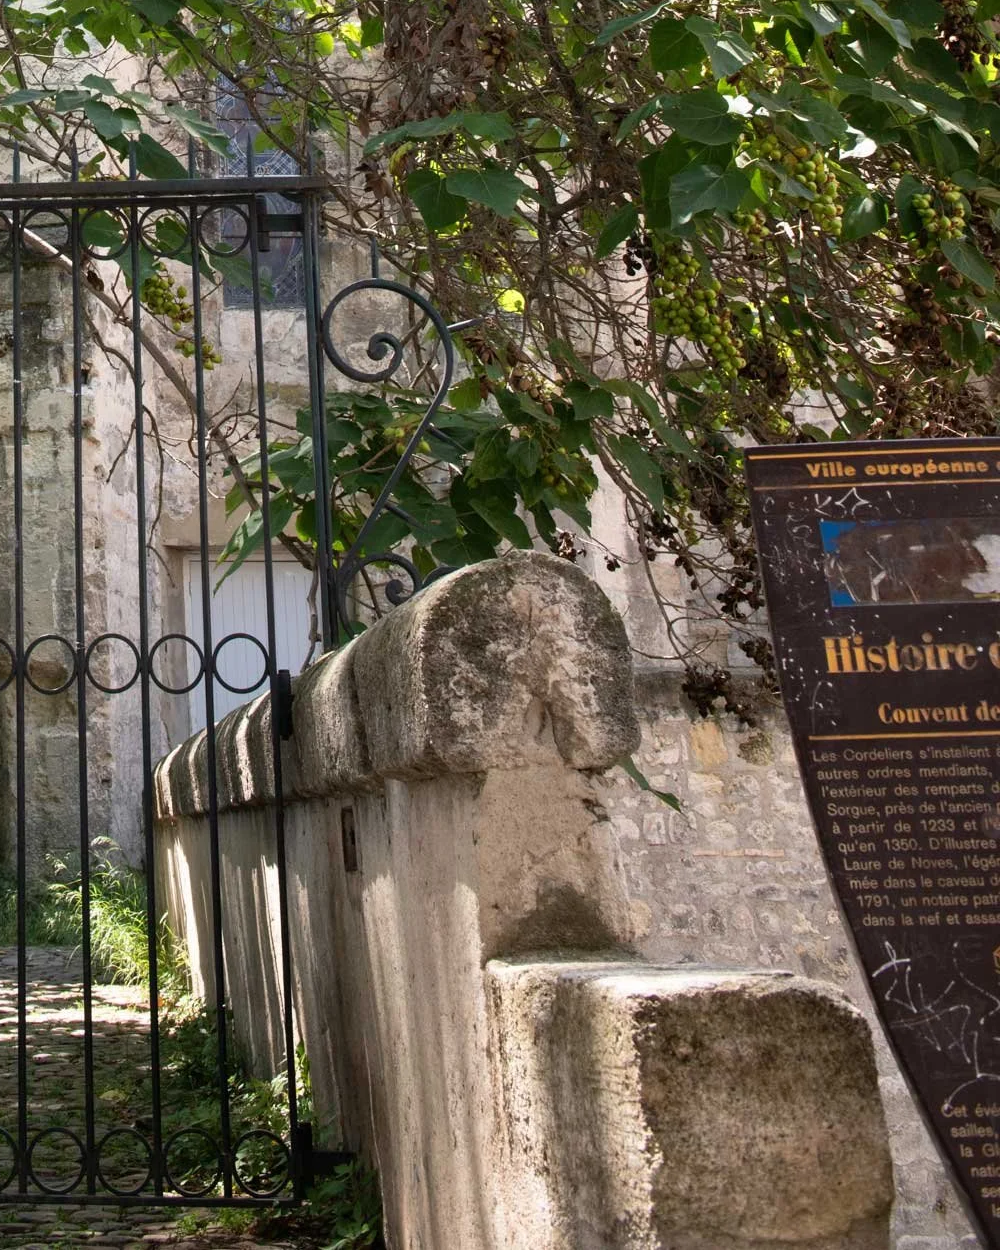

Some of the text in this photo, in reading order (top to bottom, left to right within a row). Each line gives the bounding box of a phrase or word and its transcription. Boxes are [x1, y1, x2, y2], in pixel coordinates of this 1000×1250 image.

[806, 461, 857, 478] Ville
[864, 459, 989, 478] européenne
[821, 631, 978, 673] Histoire
[878, 702, 969, 724] Couvent
[812, 748, 837, 762] Les
[843, 747, 913, 762] Cordeliers
[919, 745, 991, 760] s'installent
[817, 763, 993, 780] autres ordres mendiants,
[821, 784, 887, 798] l'extérieur
[894, 783, 919, 796] des
[925, 781, 984, 798] remparts
[827, 802, 881, 818] Sorgue,
[885, 801, 914, 816] près
[919, 800, 936, 814] de
[940, 799, 992, 813] l'ancien
[832, 821, 841, 835] à
[849, 820, 886, 836] partir
[894, 819, 912, 833] de
[920, 819, 956, 832] 1233
[963, 819, 978, 832] et
[838, 836, 997, 855] qu'en 1350. D'illustres
[843, 857, 882, 871] Laure
[888, 856, 906, 870] de
[911, 856, 958, 871] Noves,
[849, 875, 879, 889] mée
[883, 875, 916, 889] dans
[920, 874, 933, 888] le
[937, 875, 985, 888] caveau
[856, 894, 896, 909] 1791,
[901, 896, 918, 907] un
[922, 892, 968, 907] notaire
[862, 913, 895, 927] dans
[901, 912, 914, 926] la
[919, 911, 942, 926] nef
[946, 912, 960, 926] et
[941, 1102, 968, 1118] Cet
[951, 1121, 999, 1140] sailles,
[960, 1143, 974, 1158] la
